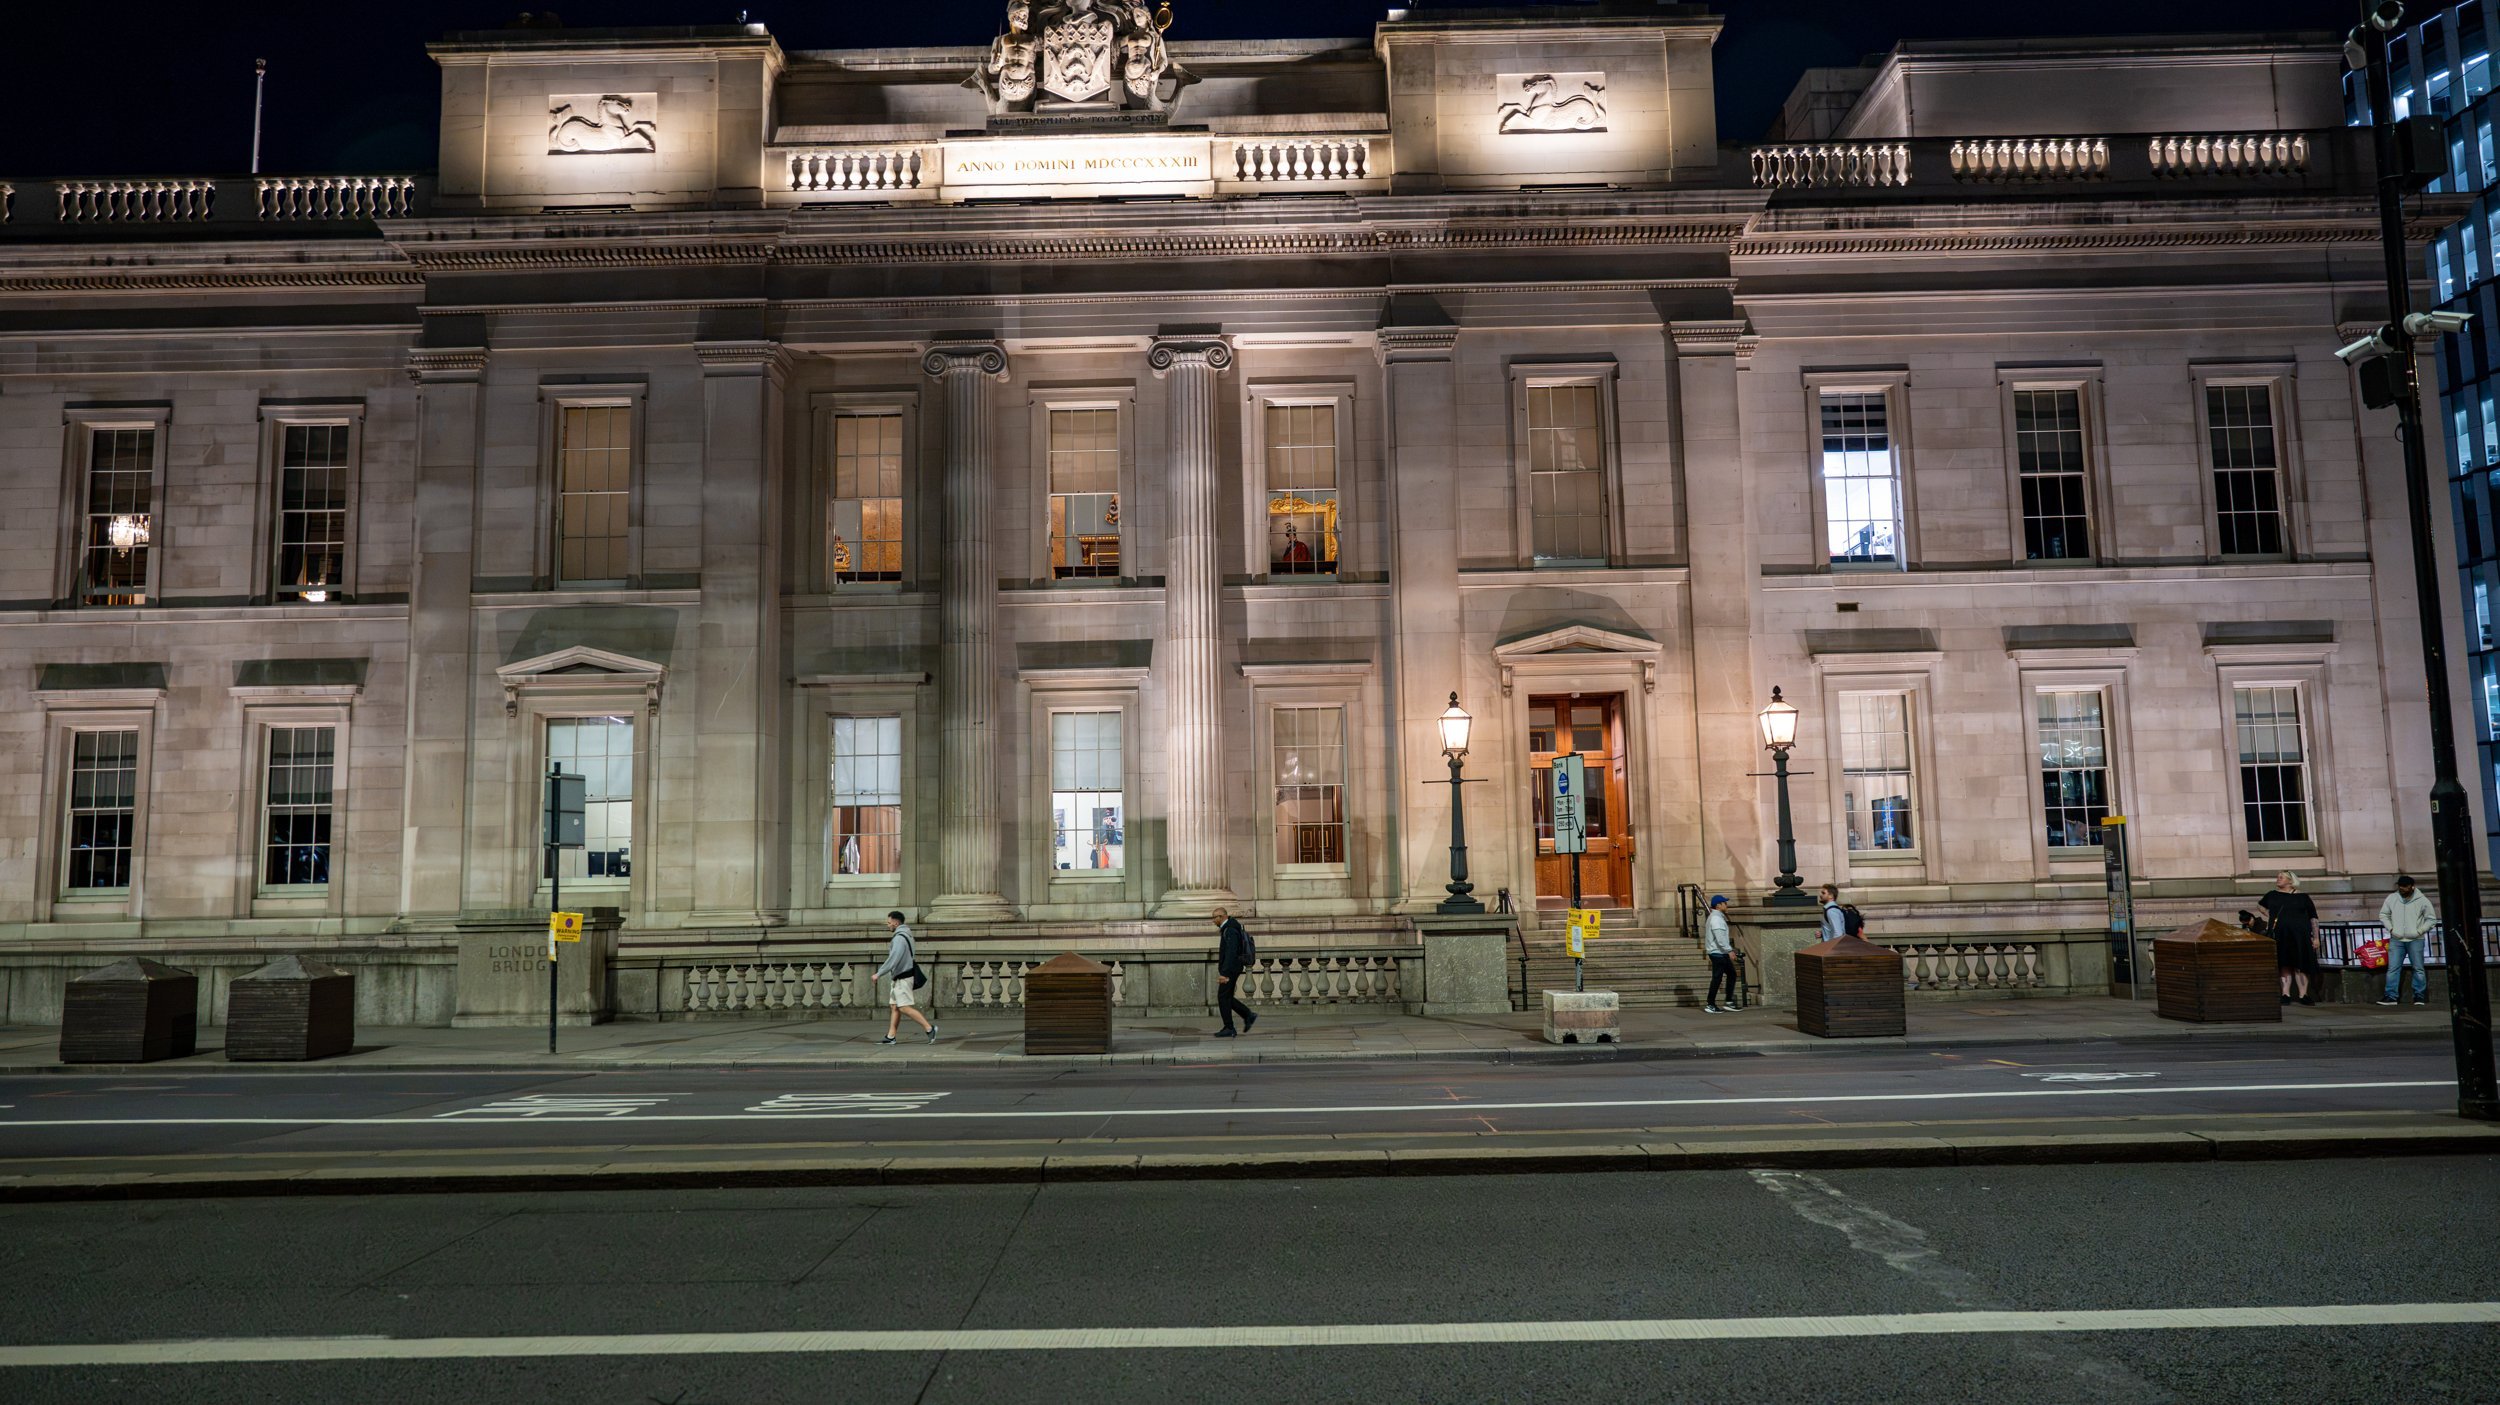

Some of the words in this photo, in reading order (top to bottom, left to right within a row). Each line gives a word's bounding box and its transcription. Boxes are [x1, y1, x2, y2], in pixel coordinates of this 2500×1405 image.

[992, 118, 1012, 126] ALL
[1070, 116, 1084, 124] BE
[1109, 115, 1132, 123] GOD
[1135, 114, 1162, 122] ONLY
[957, 160, 1005, 172] ANNO
[1014, 159, 1076, 171] DOMINI
[1084, 156, 1198, 170] MDCCCXXXIII
[489, 946, 560, 958] LONDO
[492, 960, 560, 972] BRIDG
[432, 1092, 694, 1118] LANE
[744, 1092, 952, 1112] BUS
